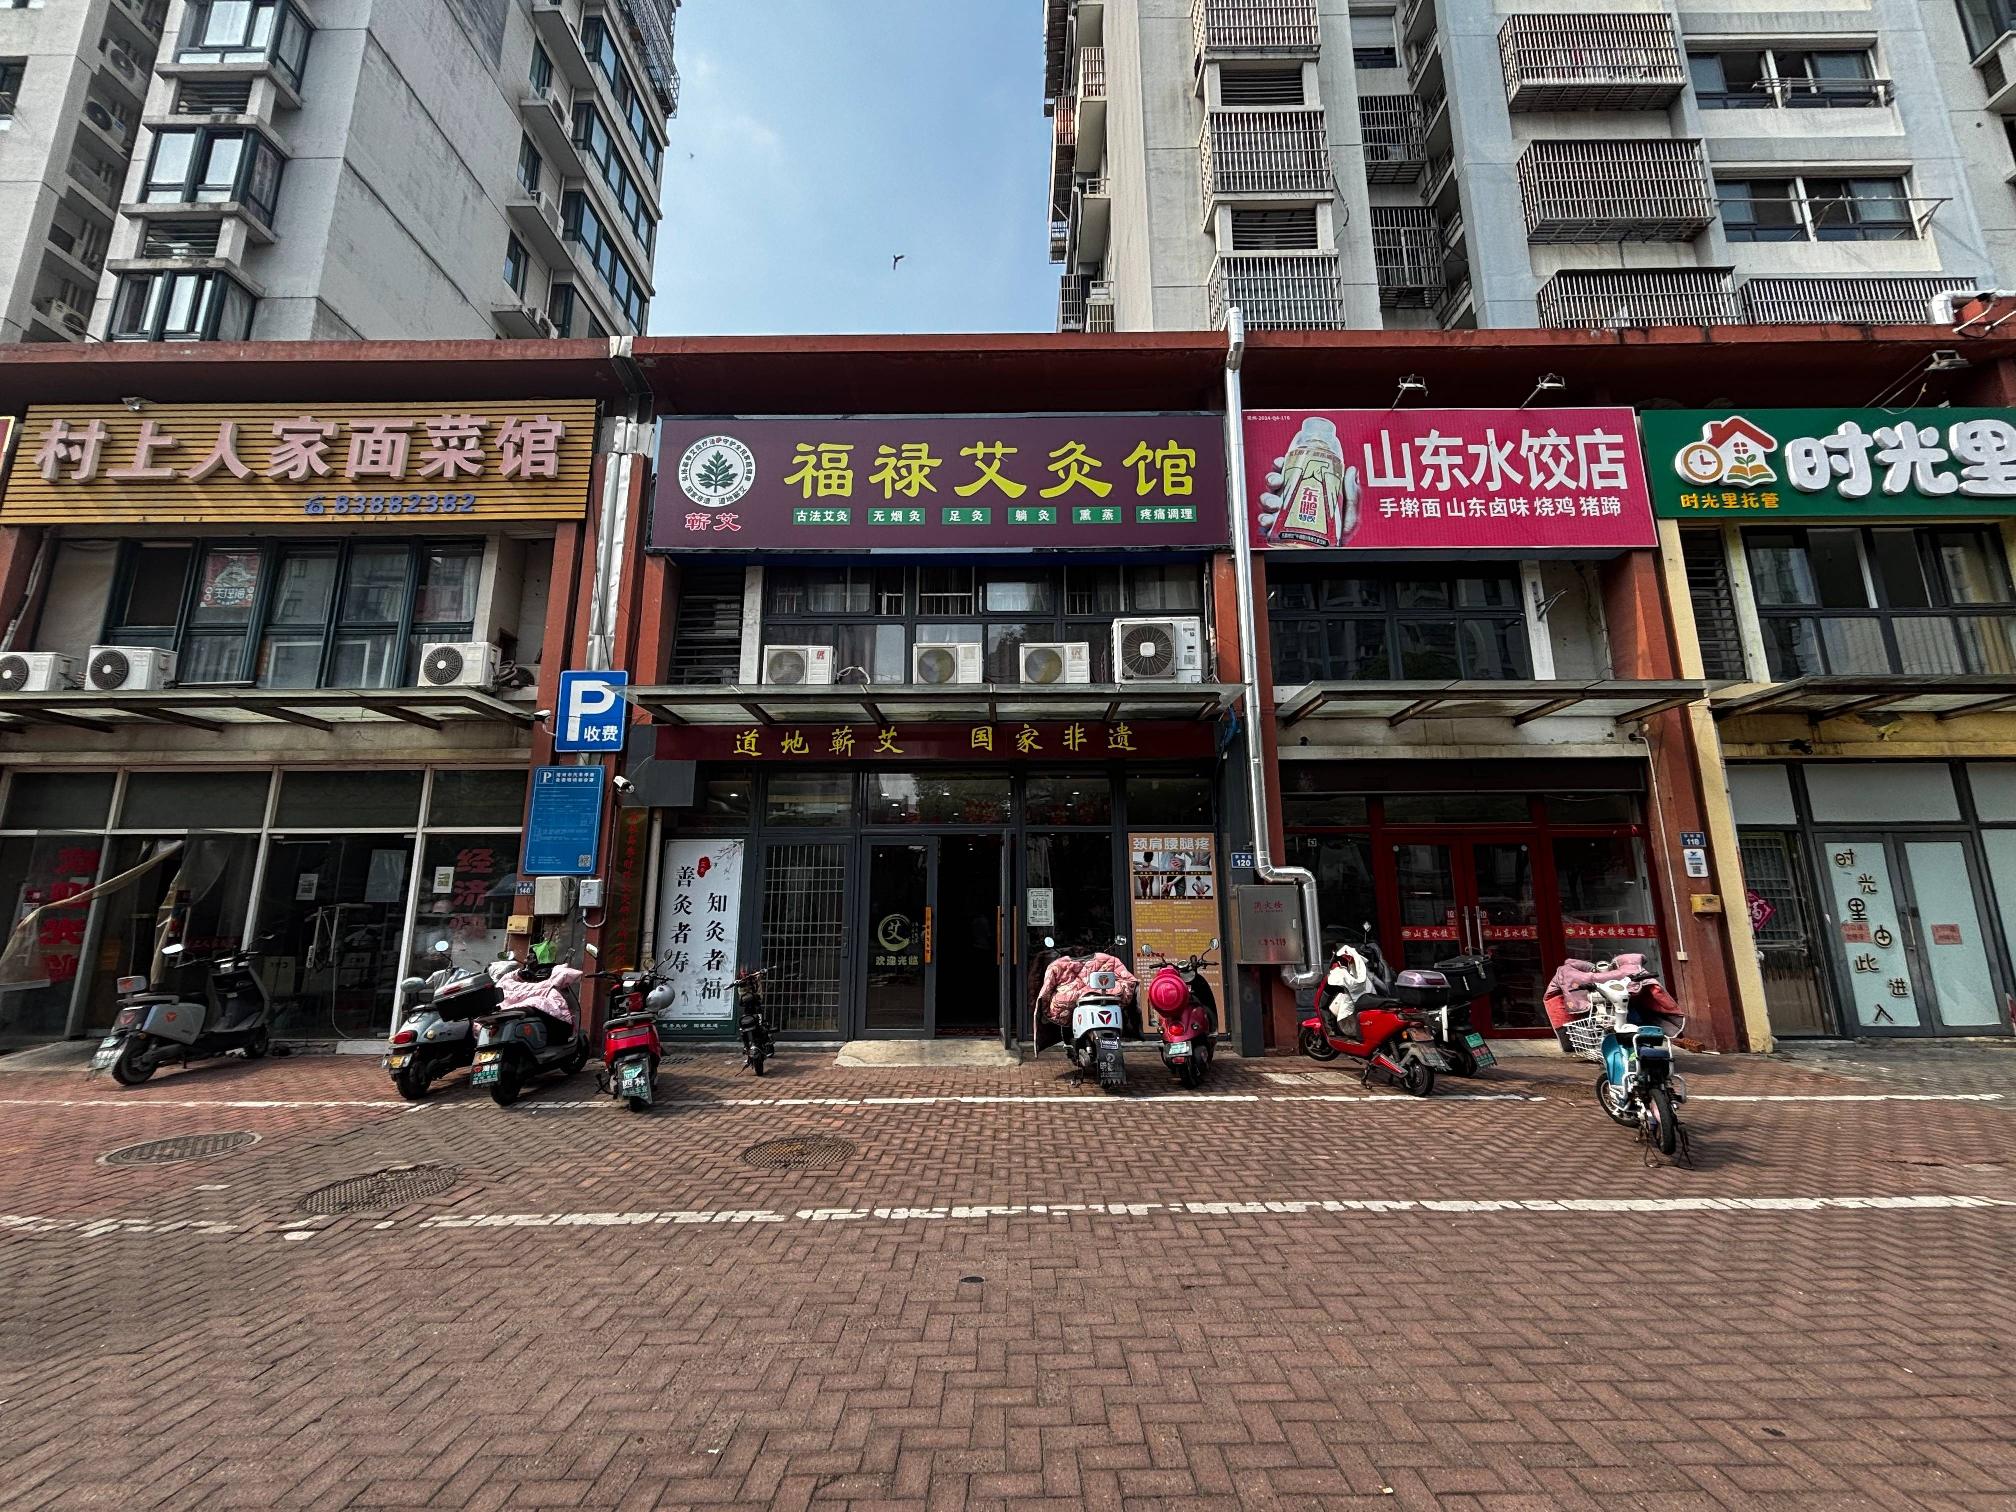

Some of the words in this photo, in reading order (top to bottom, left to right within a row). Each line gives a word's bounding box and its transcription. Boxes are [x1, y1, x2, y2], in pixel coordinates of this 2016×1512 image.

[35, 414, 566, 483] 村上人家面菜馆
[1364, 427, 1628, 492] 山东水饺店
[1785, 420, 2016, 498] 时光里
[783, 440, 1197, 500] 福禄艾灸馆
[334, 493, 475, 513] 83882382
[1379, 498, 1441, 518] 手擀面
[1447, 497, 1531, 518] 山东卤味
[1535, 497, 1576, 517] 烧鸡
[1580, 496, 1621, 517] 猪蹄
[1680, 493, 1780, 509] 时光里托管
[684, 512, 742, 531] 蕲艾
[796, 508, 848, 523] 古法艾灸
[873, 508, 922, 523] 无烟灸
[949, 508, 983, 523] 足灸
[1015, 508, 1050, 523] 躺灸
[1139, 506, 1193, 522] 疼痛调理
[567, 680, 616, 742] P
[583, 725, 618, 742] 收费
[733, 725, 905, 757] 道地蕲艾
[971, 722, 1138, 754] 国家非遗
[1133, 837, 1210, 851] 颈肩腰腿疼
[1236, 859, 1251, 867] 120
[668, 866, 696, 973] 善灸者寿
[700, 892, 728, 1000] 知灸者福
[875, 955, 919, 966] 欢迎光临
